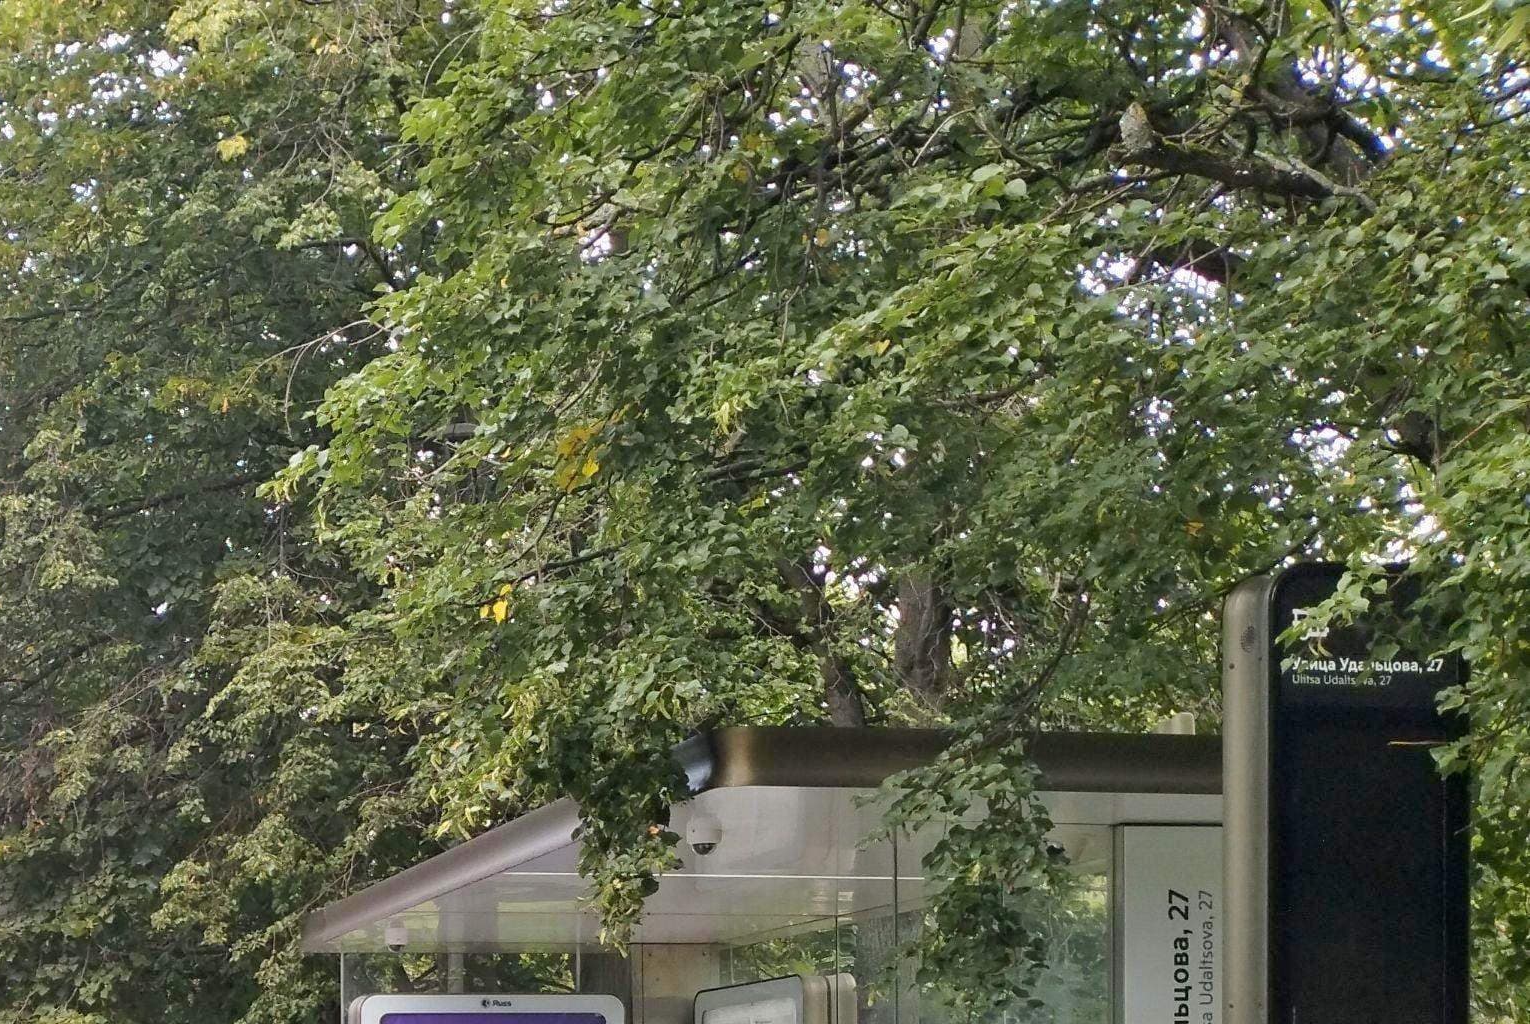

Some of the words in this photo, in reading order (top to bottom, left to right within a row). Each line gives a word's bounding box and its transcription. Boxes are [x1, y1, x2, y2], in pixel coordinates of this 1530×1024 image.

[1426, 659, 1444, 672] 27
[1292, 675, 1320, 685] Ulitsa
[1379, 676, 1392, 686] 27
[1168, 889, 1190, 921] 27
[1198, 890, 1213, 911] 27
[1198, 916, 1215, 1005] Udaltsova,
